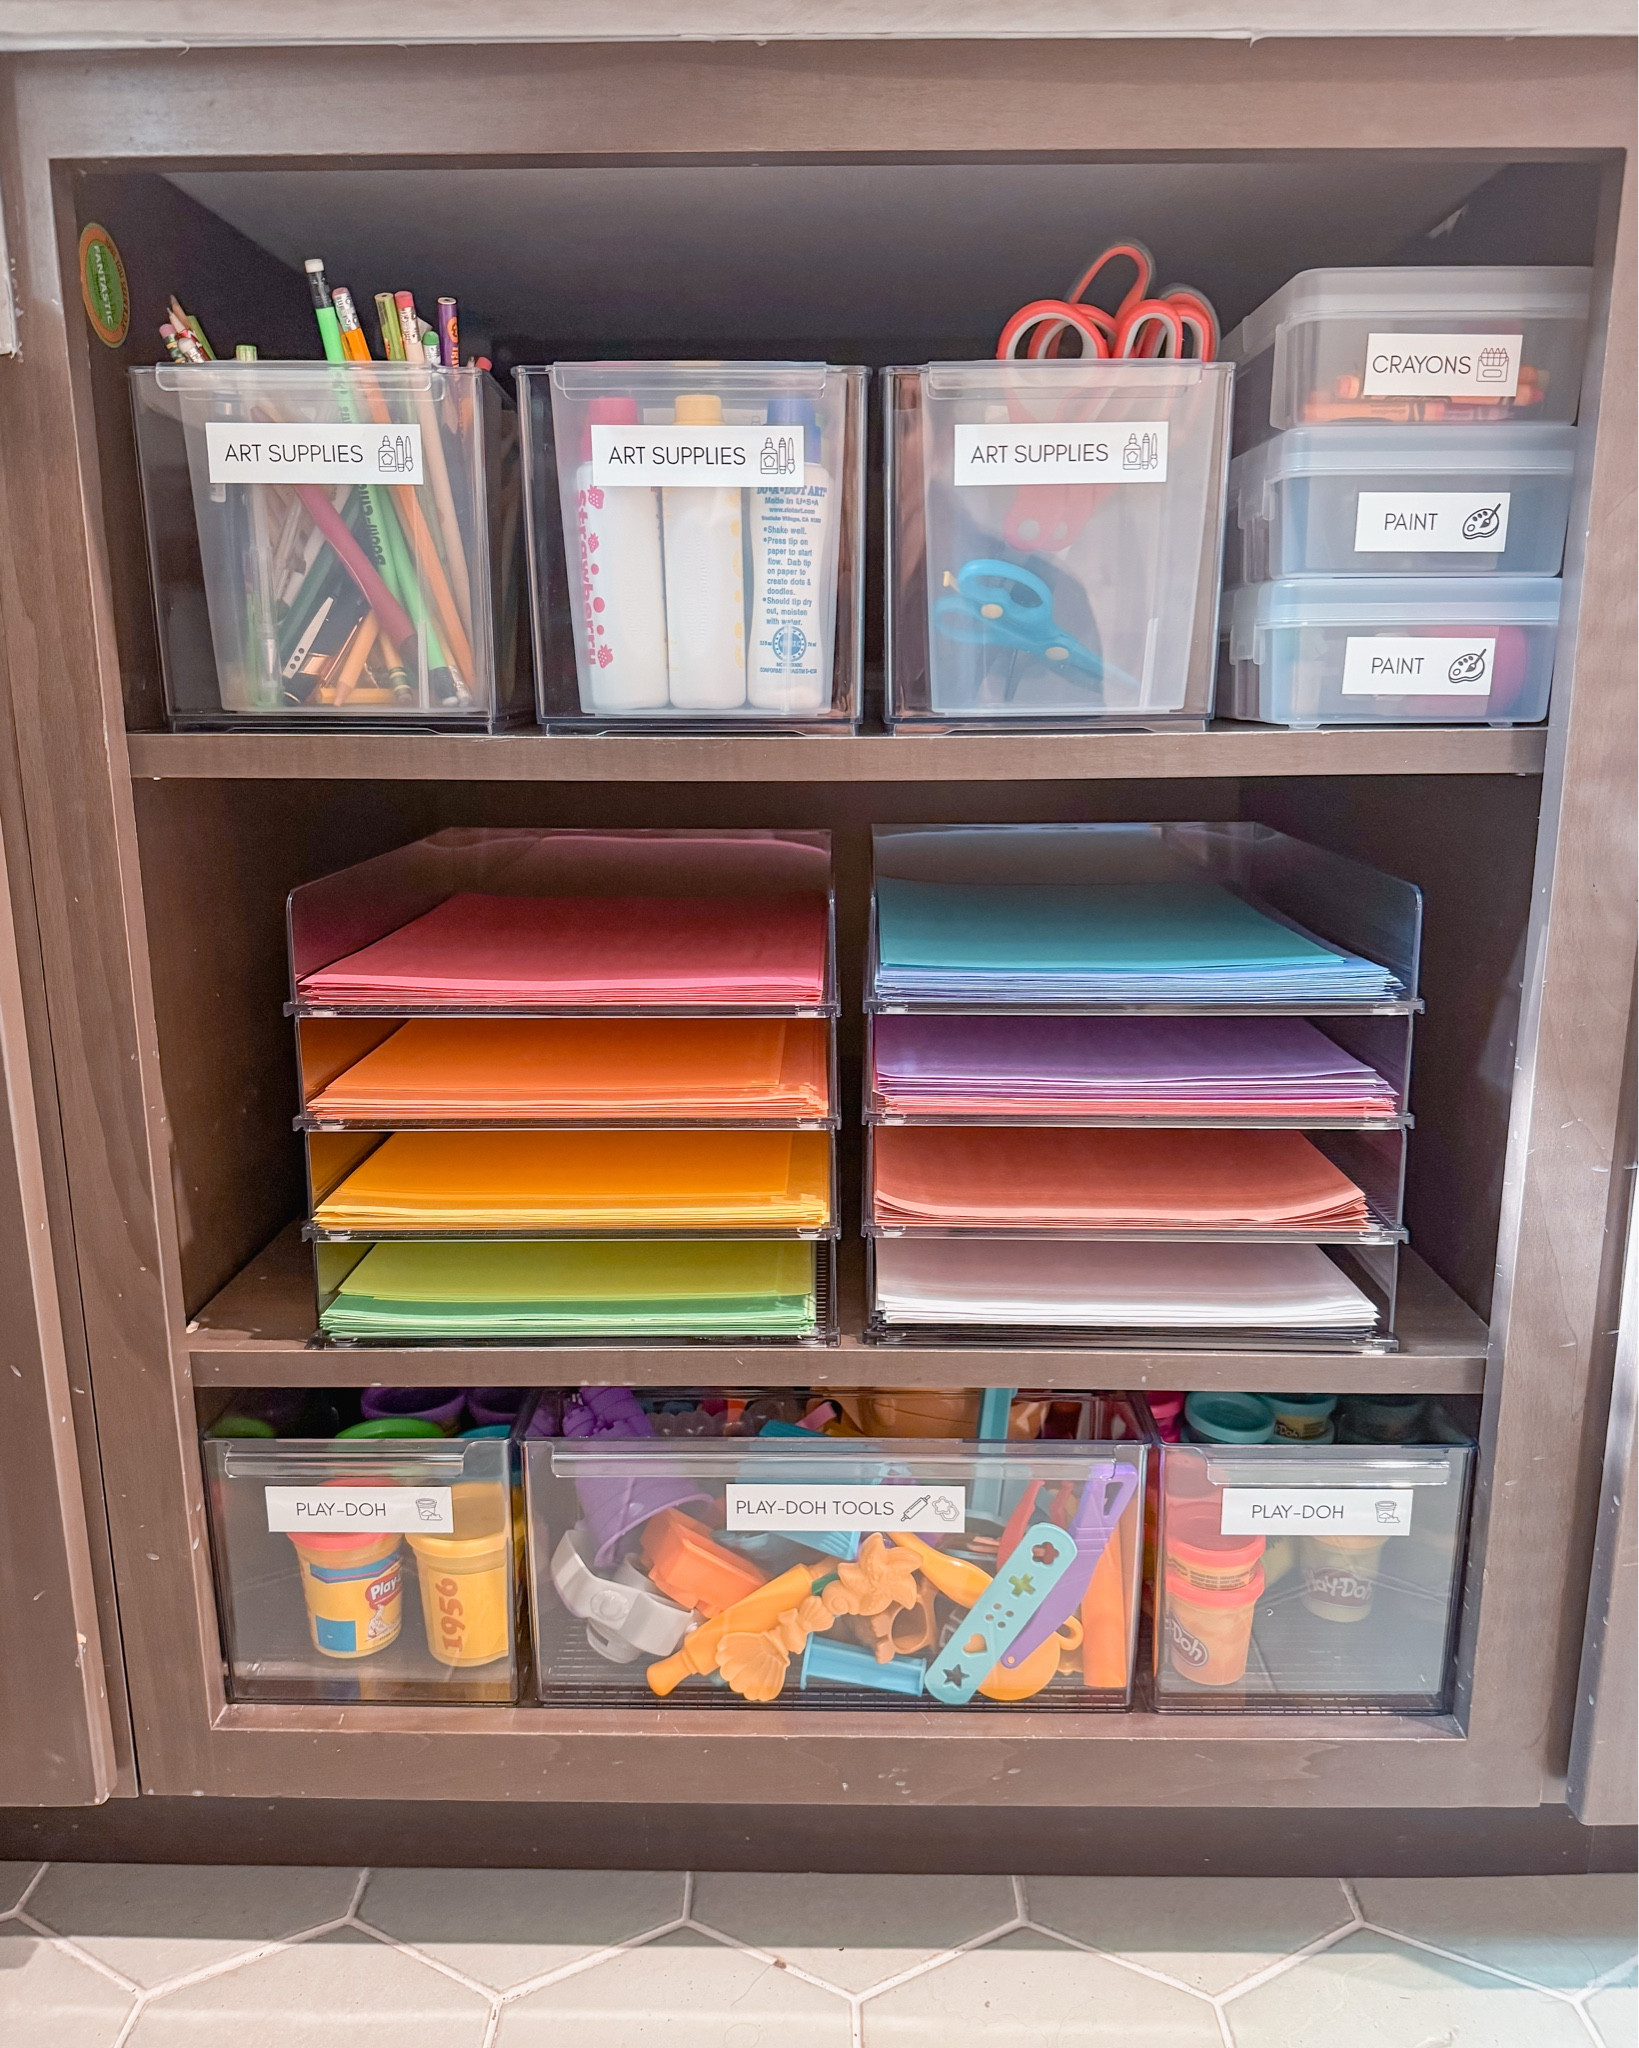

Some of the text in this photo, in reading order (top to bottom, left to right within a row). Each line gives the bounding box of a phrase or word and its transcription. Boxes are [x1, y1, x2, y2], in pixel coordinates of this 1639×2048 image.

[94, 245, 113, 325] FANTASTIC
[1373, 355, 1472, 375] CRAYONS
[225, 443, 364, 464] ART SUPPLIES
[608, 446, 746, 466] ART SUPPLIES
[970, 443, 1109, 464] ART SUPPLIES
[764, 497, 785, 505] Made
[786, 497, 794, 505] in
[1384, 512, 1439, 531] PAINT
[790, 527, 808, 535] well.
[788, 537, 798, 547] tip
[767, 548, 812, 557] paper to start
[767, 557, 812, 569] flow. Dab tip
[777, 569, 798, 577] paper
[790, 578, 806, 586] dots
[767, 587, 796, 596] doodles.
[767, 596, 813, 608] Should tip dry
[766, 607, 808, 616] out, moisten
[766, 617, 779, 625] with
[1371, 657, 1425, 675] PAINT
[296, 1502, 387, 1517] PLAY-DOH
[736, 1500, 895, 1516] PLAY-DOH TOOLS
[1251, 1504, 1344, 1519] PLAY-DOH
[435, 1578, 466, 1652] 1956
